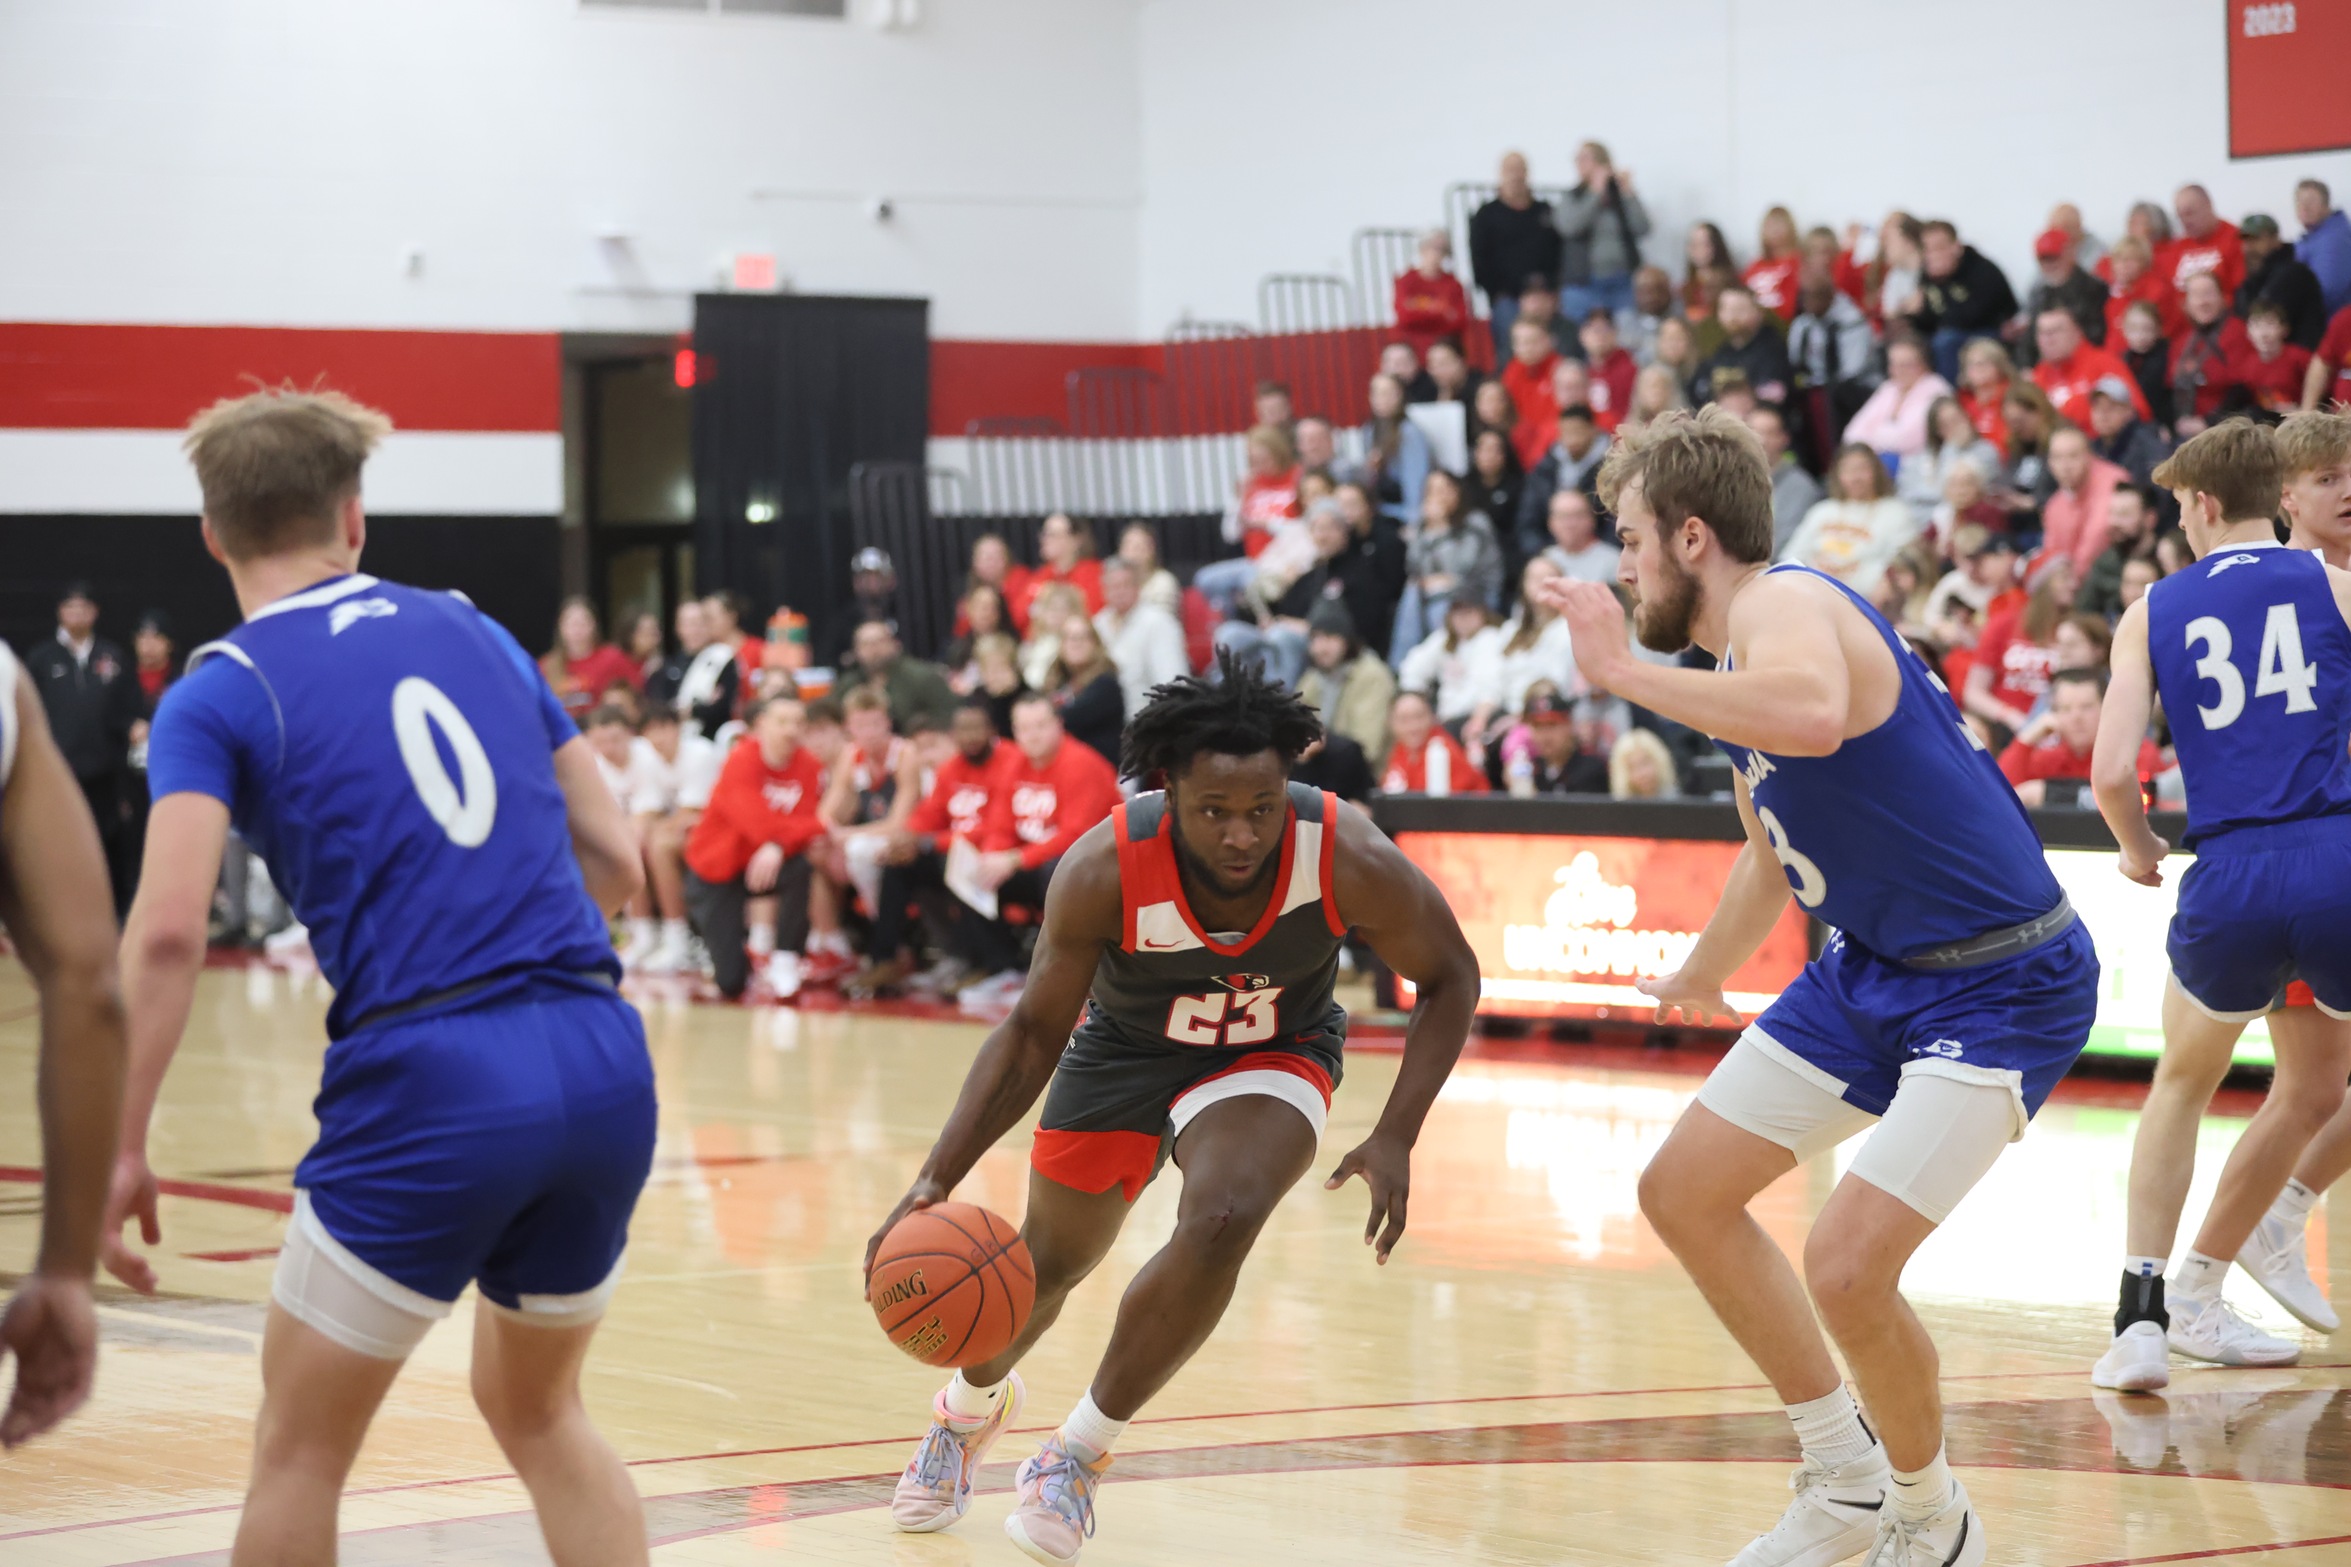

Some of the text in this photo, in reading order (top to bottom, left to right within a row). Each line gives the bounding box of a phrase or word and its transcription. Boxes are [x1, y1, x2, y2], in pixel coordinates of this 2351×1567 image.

[2185, 602, 2318, 731] 34
[391, 675, 497, 848] 0
[1164, 986, 1285, 1046] 23
